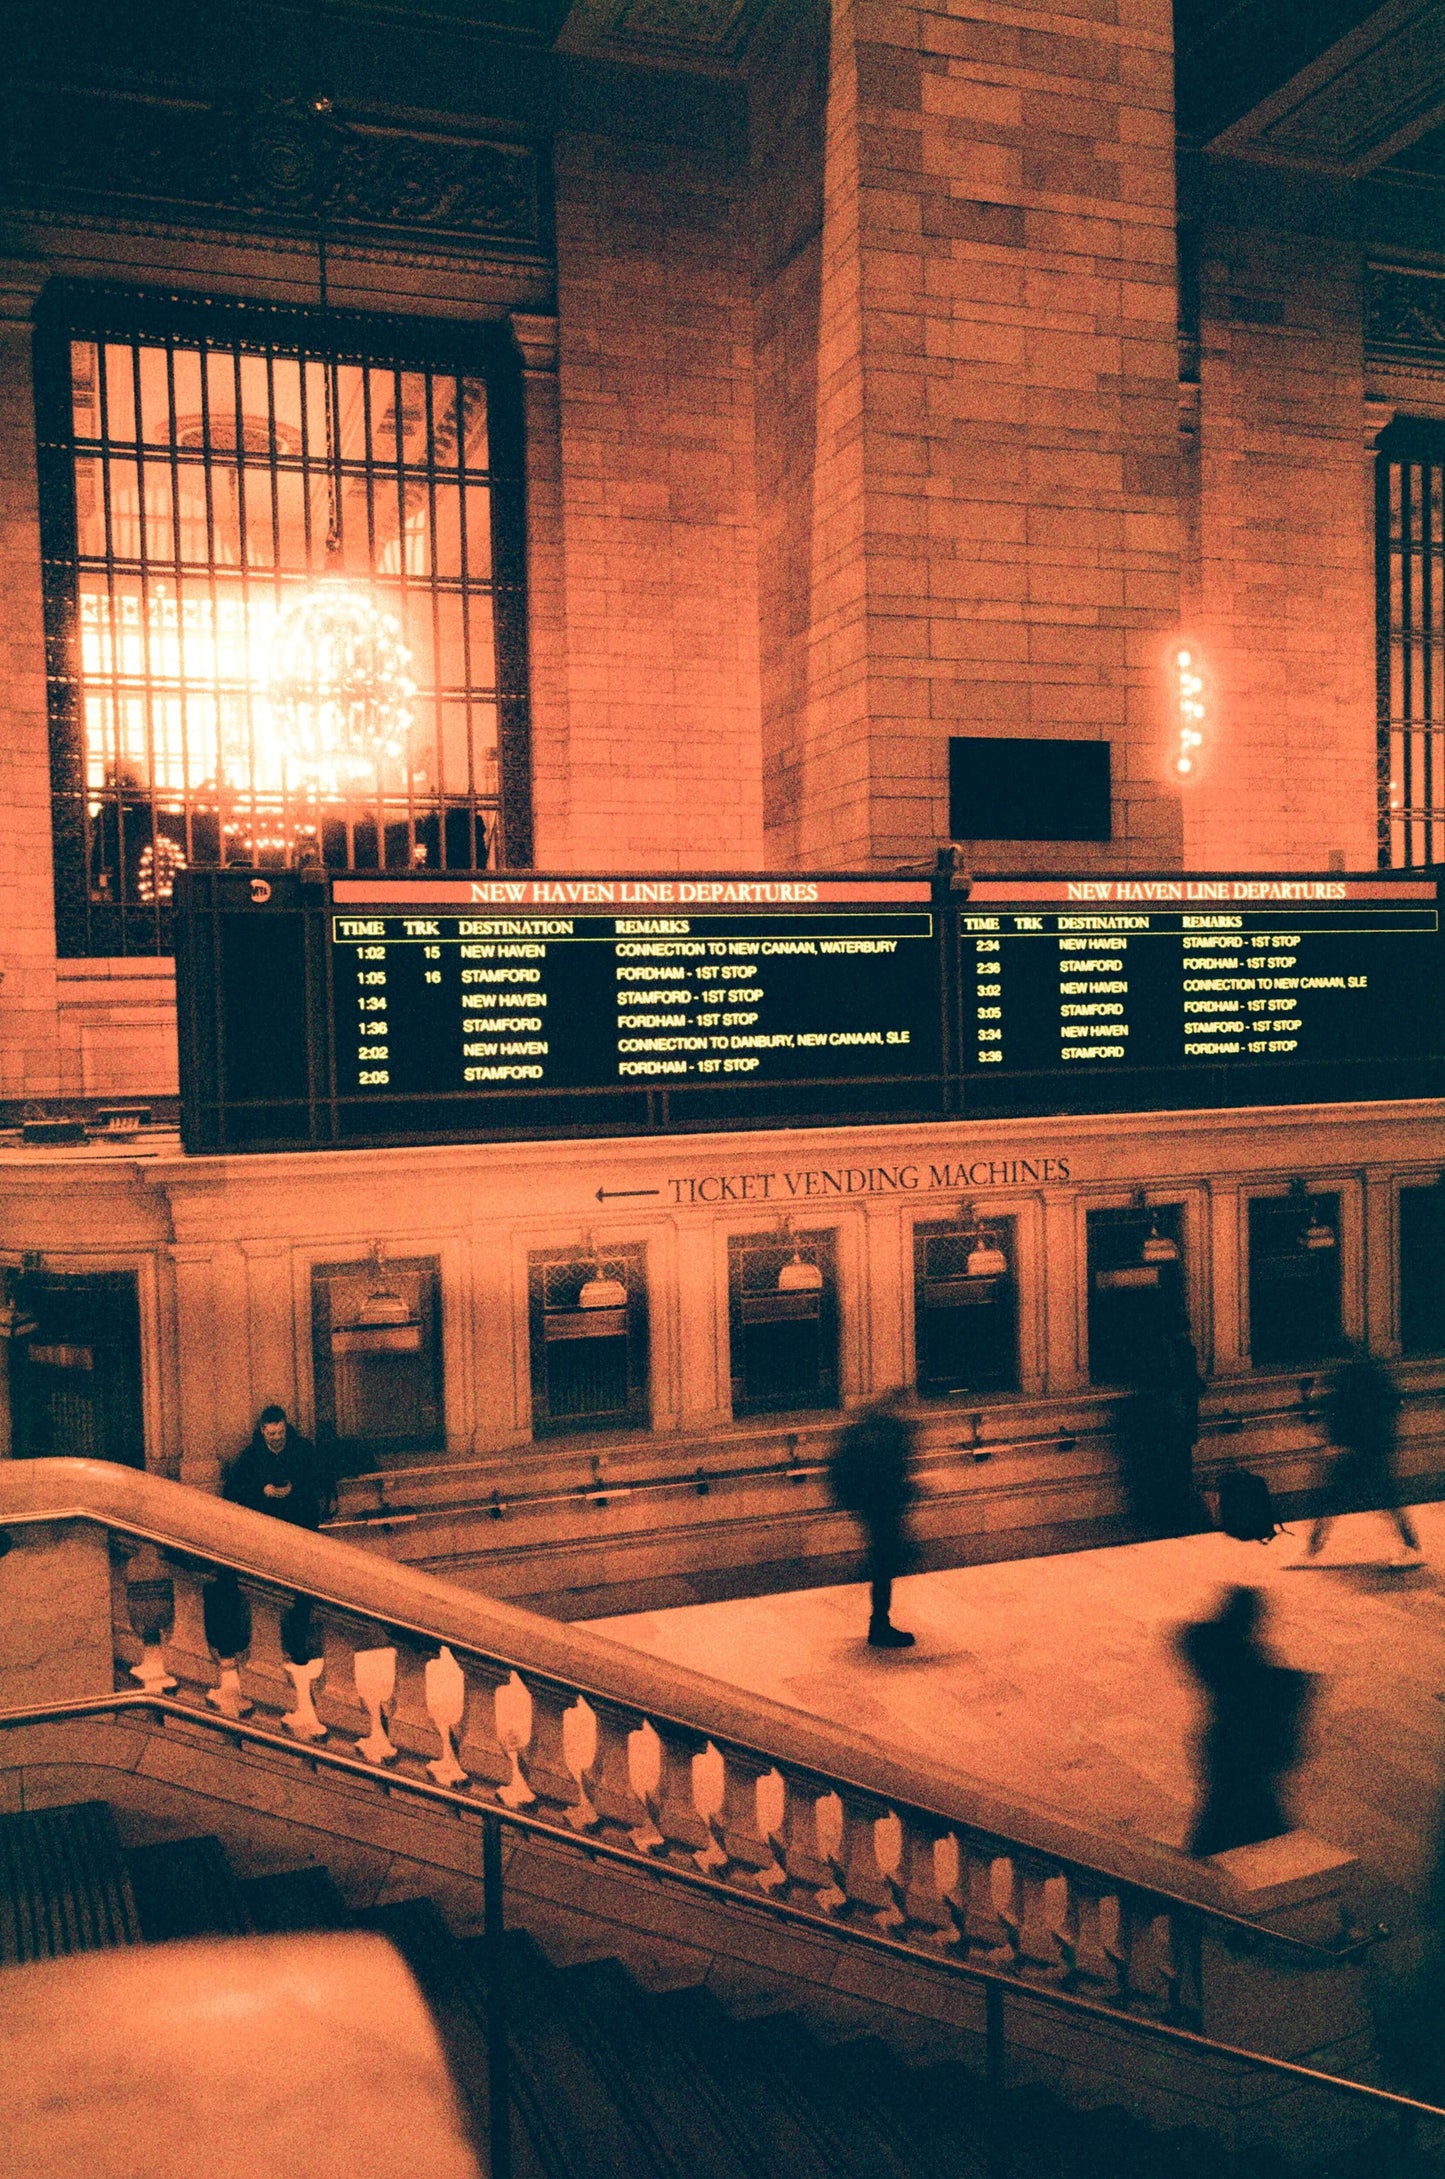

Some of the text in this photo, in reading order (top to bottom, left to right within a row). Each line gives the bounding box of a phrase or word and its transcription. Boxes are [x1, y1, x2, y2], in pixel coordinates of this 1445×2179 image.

[471, 884, 817, 901] NEW HAVEN LINE DEPARTURES
[1068, 883, 1345, 899] NEW HAVEN LINE DEPARTURES
[339, 921, 385, 935] TIME
[403, 921, 440, 935] TRK
[459, 921, 573, 935] DESTINATION
[615, 920, 690, 934] REMARKS
[964, 918, 1000, 930] TIME
[1014, 918, 1043, 929] TRK
[1058, 917, 1149, 929] DESTINATION
[1182, 916, 1242, 928] REMARKS
[616, 941, 897, 956] CONNECTION TO NEW CANAAN, WATERBURY
[976, 940, 1000, 951] 2:34
[1059, 938, 1127, 950] NEW HAVEN
[1183, 937, 1243, 948] STAMFORD
[1251, 937, 1271, 947] 1ST
[1272, 936, 1301, 947] STOP
[357, 947, 385, 959] 1:02
[424, 947, 440, 959] 15
[461, 945, 545, 958] NEW HAVEN
[1060, 960, 1123, 972] STAMFORD
[1183, 958, 1238, 970] FORDHAM
[1246, 957, 1266, 969] 1ST
[1268, 957, 1296, 968] STOP
[357, 972, 386, 984] 1:05
[425, 971, 441, 983] 16
[461, 969, 540, 983] STAMFORD
[616, 967, 685, 980] FORDHAM
[695, 966, 719, 979] 1ST
[721, 966, 757, 979] STOP
[1060, 981, 1128, 994] NEW HAVEN
[1183, 976, 1367, 991] CONNECTION TO NEW CANAAN, SLE
[617, 991, 691, 1005] STAMFORD
[702, 990, 726, 1003] 1ST
[728, 989, 764, 1002] STOP
[977, 985, 1001, 996] 3:02
[358, 997, 387, 1010] 1:34
[462, 994, 547, 1008] NEW HAVEN
[1184, 1001, 1239, 1013] FORDHAM
[1247, 1000, 1267, 1011] 1ST
[1268, 999, 1297, 1010] STOP
[977, 1007, 1001, 1019] 3:05
[1061, 1003, 1123, 1017] STAMFORD
[463, 1018, 542, 1032] STAMFORD
[618, 1015, 686, 1028] FORDHAM
[696, 1014, 721, 1026] 1ST
[722, 1013, 758, 1026] STOP
[1184, 1022, 1244, 1034] STAMFORD
[1252, 1021, 1272, 1032] 1ST
[1273, 1020, 1302, 1031] STOP
[978, 1029, 1002, 1041] 3:34
[1061, 1025, 1128, 1038] NEW HAVEN
[618, 1031, 910, 1052] CONNECTION TO DANBURY, NEW CANAAN, SLE
[1185, 1043, 1239, 1055] FORDHAM
[1248, 1042, 1267, 1053] 1ST
[1269, 1041, 1297, 1052] STOP
[359, 1047, 388, 1060] 2:02
[463, 1042, 548, 1056] NEW HAVEN
[1062, 1046, 1124, 1059] STAMFORD
[619, 1061, 687, 1075] FORDHAM
[697, 1060, 722, 1072] 1ST
[724, 1058, 759, 1072] STOP
[359, 1072, 389, 1084] 2:05
[464, 1066, 543, 1081] STAMFORD
[668, 1157, 1072, 1203] TICKET VENDING MACHINES
